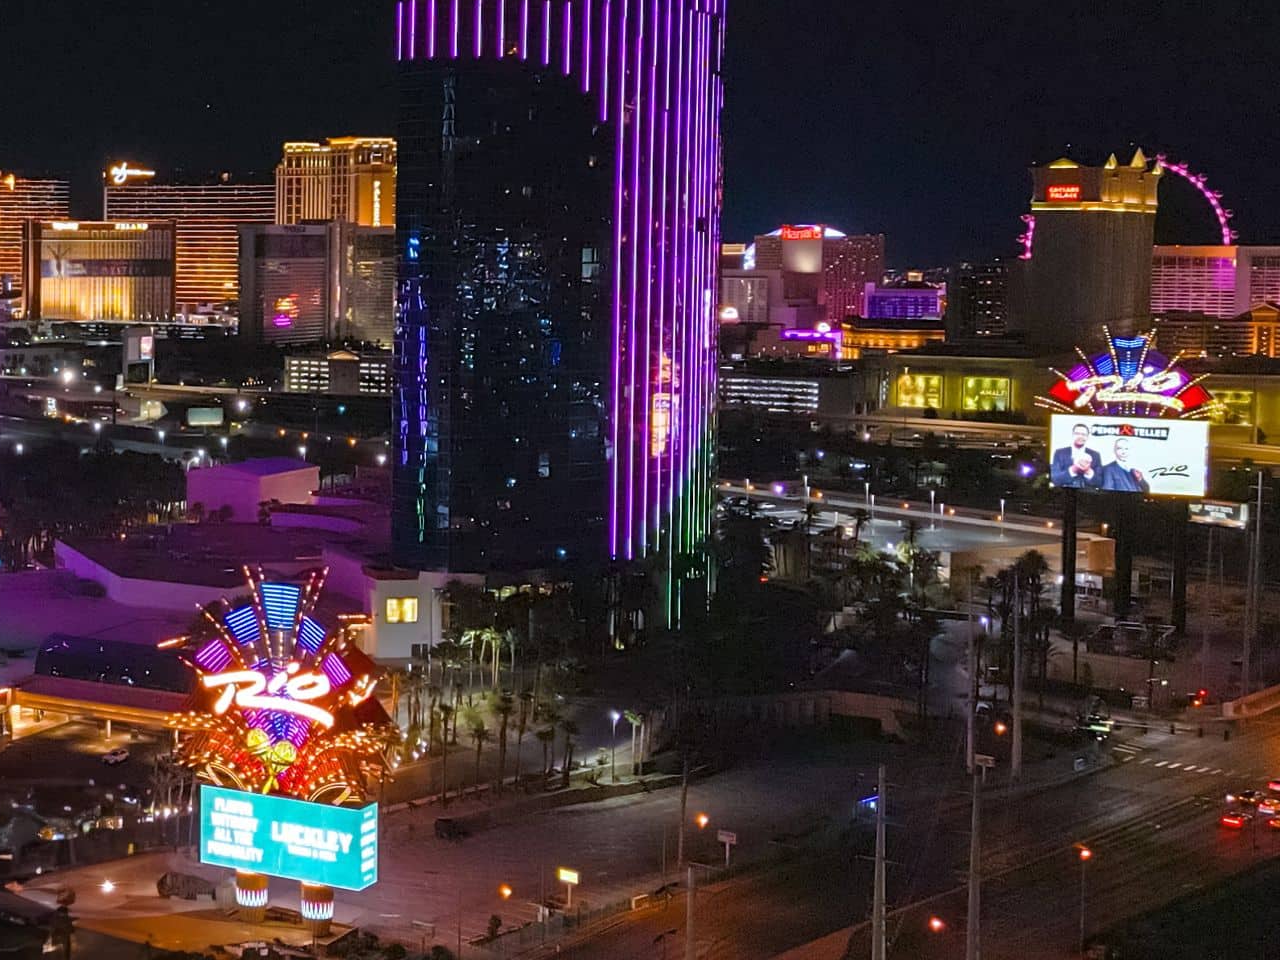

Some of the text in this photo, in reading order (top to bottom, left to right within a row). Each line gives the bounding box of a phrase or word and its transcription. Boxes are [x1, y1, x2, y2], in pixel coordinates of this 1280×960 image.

[1066, 366, 1185, 411] Rio
[1092, 426, 1120, 437] PENN
[1134, 428, 1168, 439] TELLER
[202, 661, 335, 730] Rio
